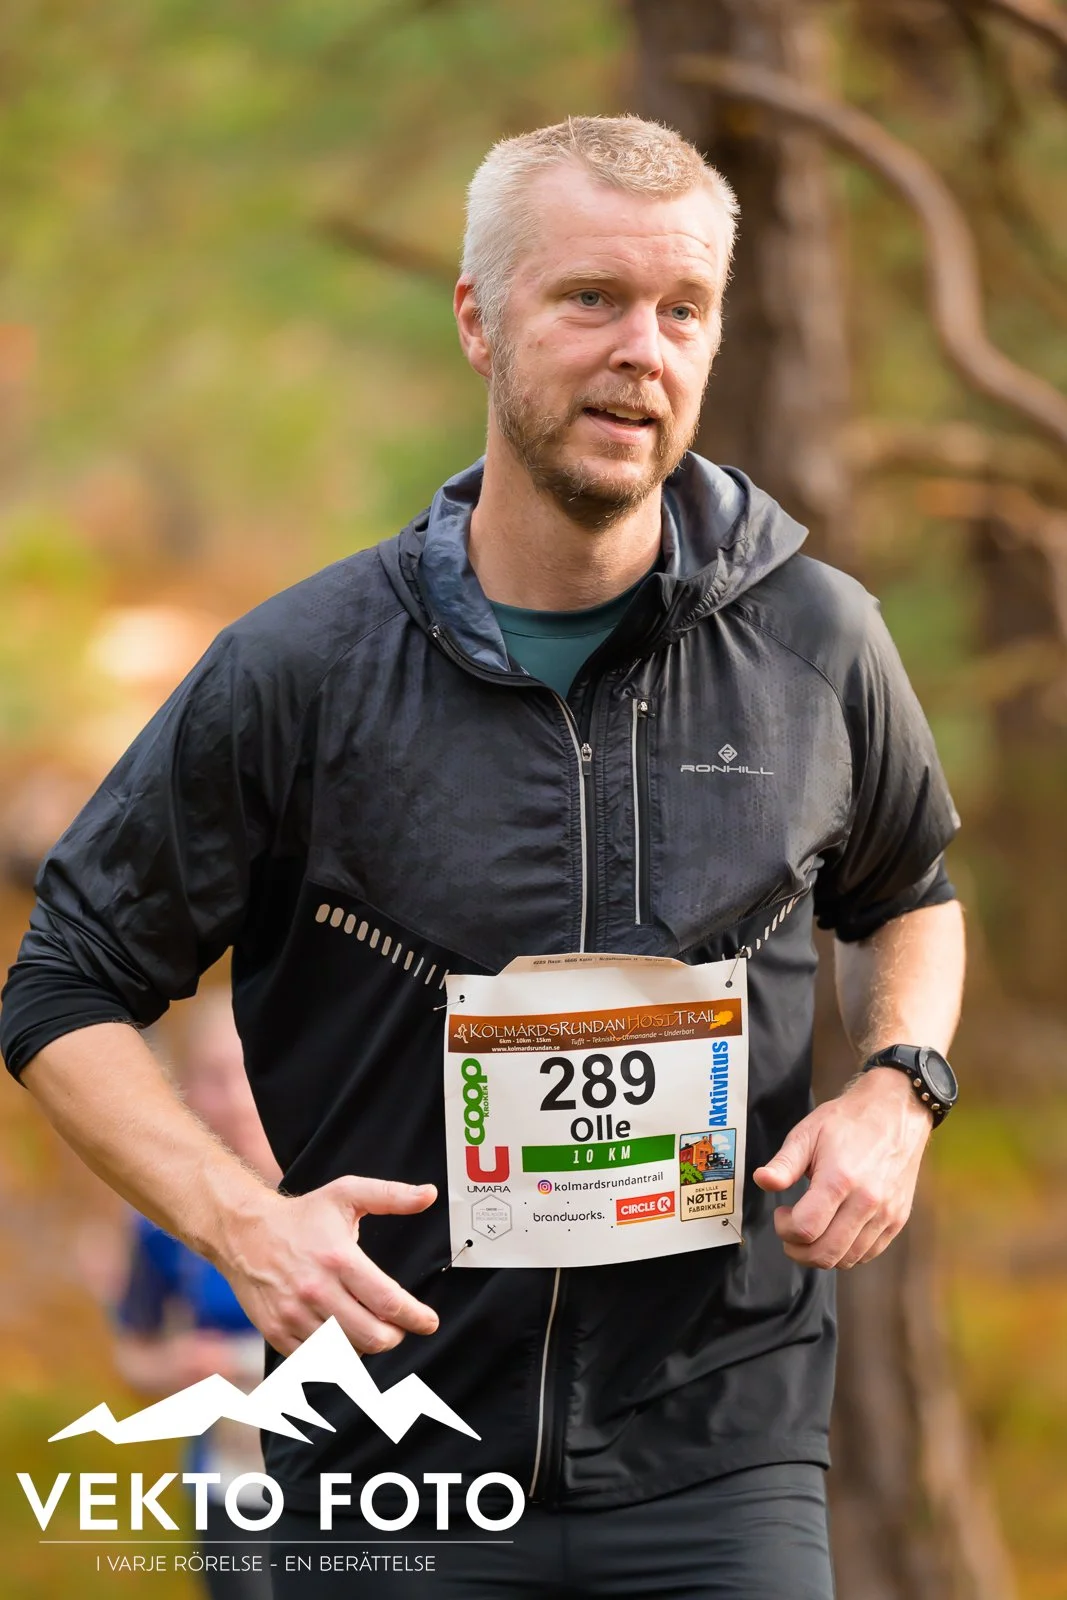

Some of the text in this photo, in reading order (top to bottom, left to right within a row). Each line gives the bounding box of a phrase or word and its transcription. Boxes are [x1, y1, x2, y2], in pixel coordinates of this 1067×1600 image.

[680, 764, 774, 775] RONHILL
[491, 1044, 560, 1052] www.kolmardsrundan.se
[539, 1050, 656, 1111] 289
[708, 1041, 729, 1126] Aktivitus
[461, 1057, 488, 1146] coop
[482, 1085, 490, 1118] KROKEK
[570, 1114, 631, 1143] Olle
[573, 1145, 631, 1164] 10 KM
[467, 1185, 511, 1193] UMARA
[554, 1171, 664, 1192] kolmardsrundantrail
[620, 1196, 671, 1215] CIRCLE K
[686, 1190, 728, 1206] NØTTE
[532, 1211, 605, 1222] brandworks.
[688, 1203, 726, 1213] FABRIKKEN
